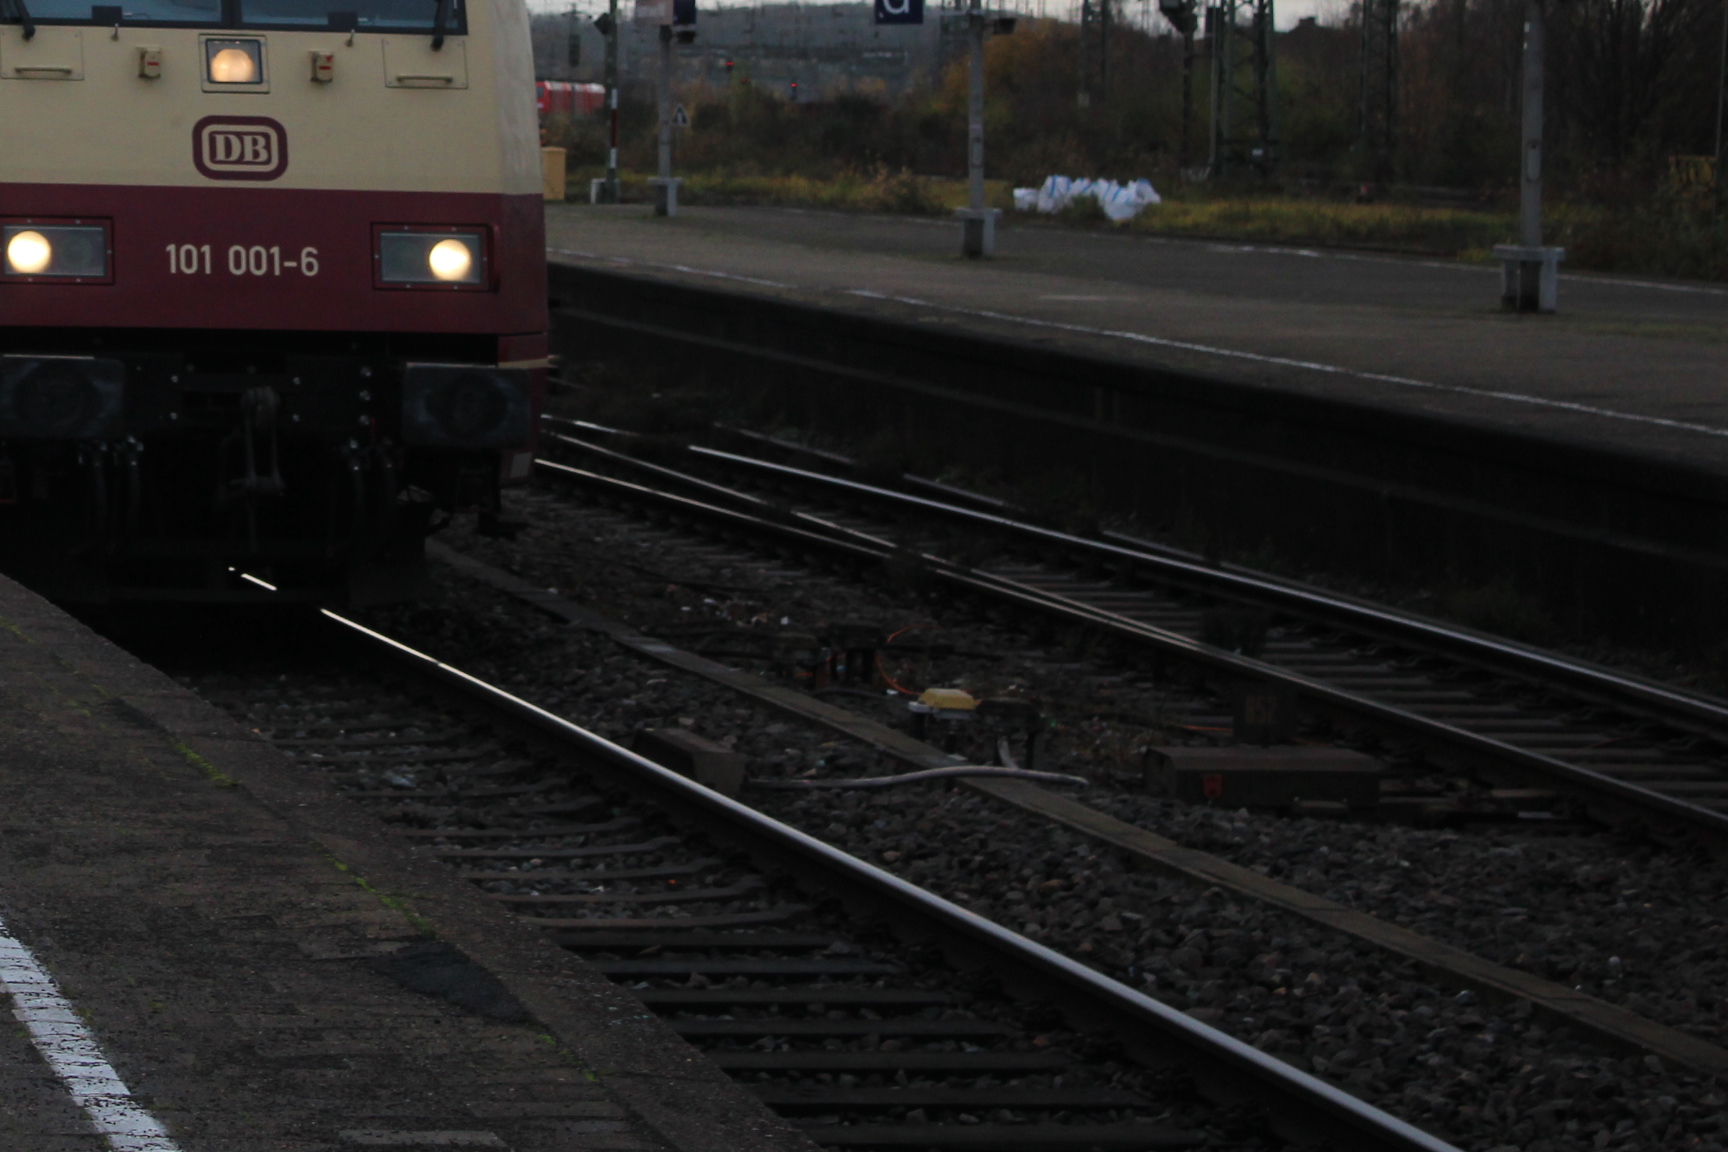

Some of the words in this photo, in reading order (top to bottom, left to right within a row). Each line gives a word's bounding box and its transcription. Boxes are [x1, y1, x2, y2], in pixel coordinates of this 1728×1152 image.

[212, 133, 270, 163] DB
[165, 243, 212, 275] 101
[227, 244, 320, 277] 001-6
